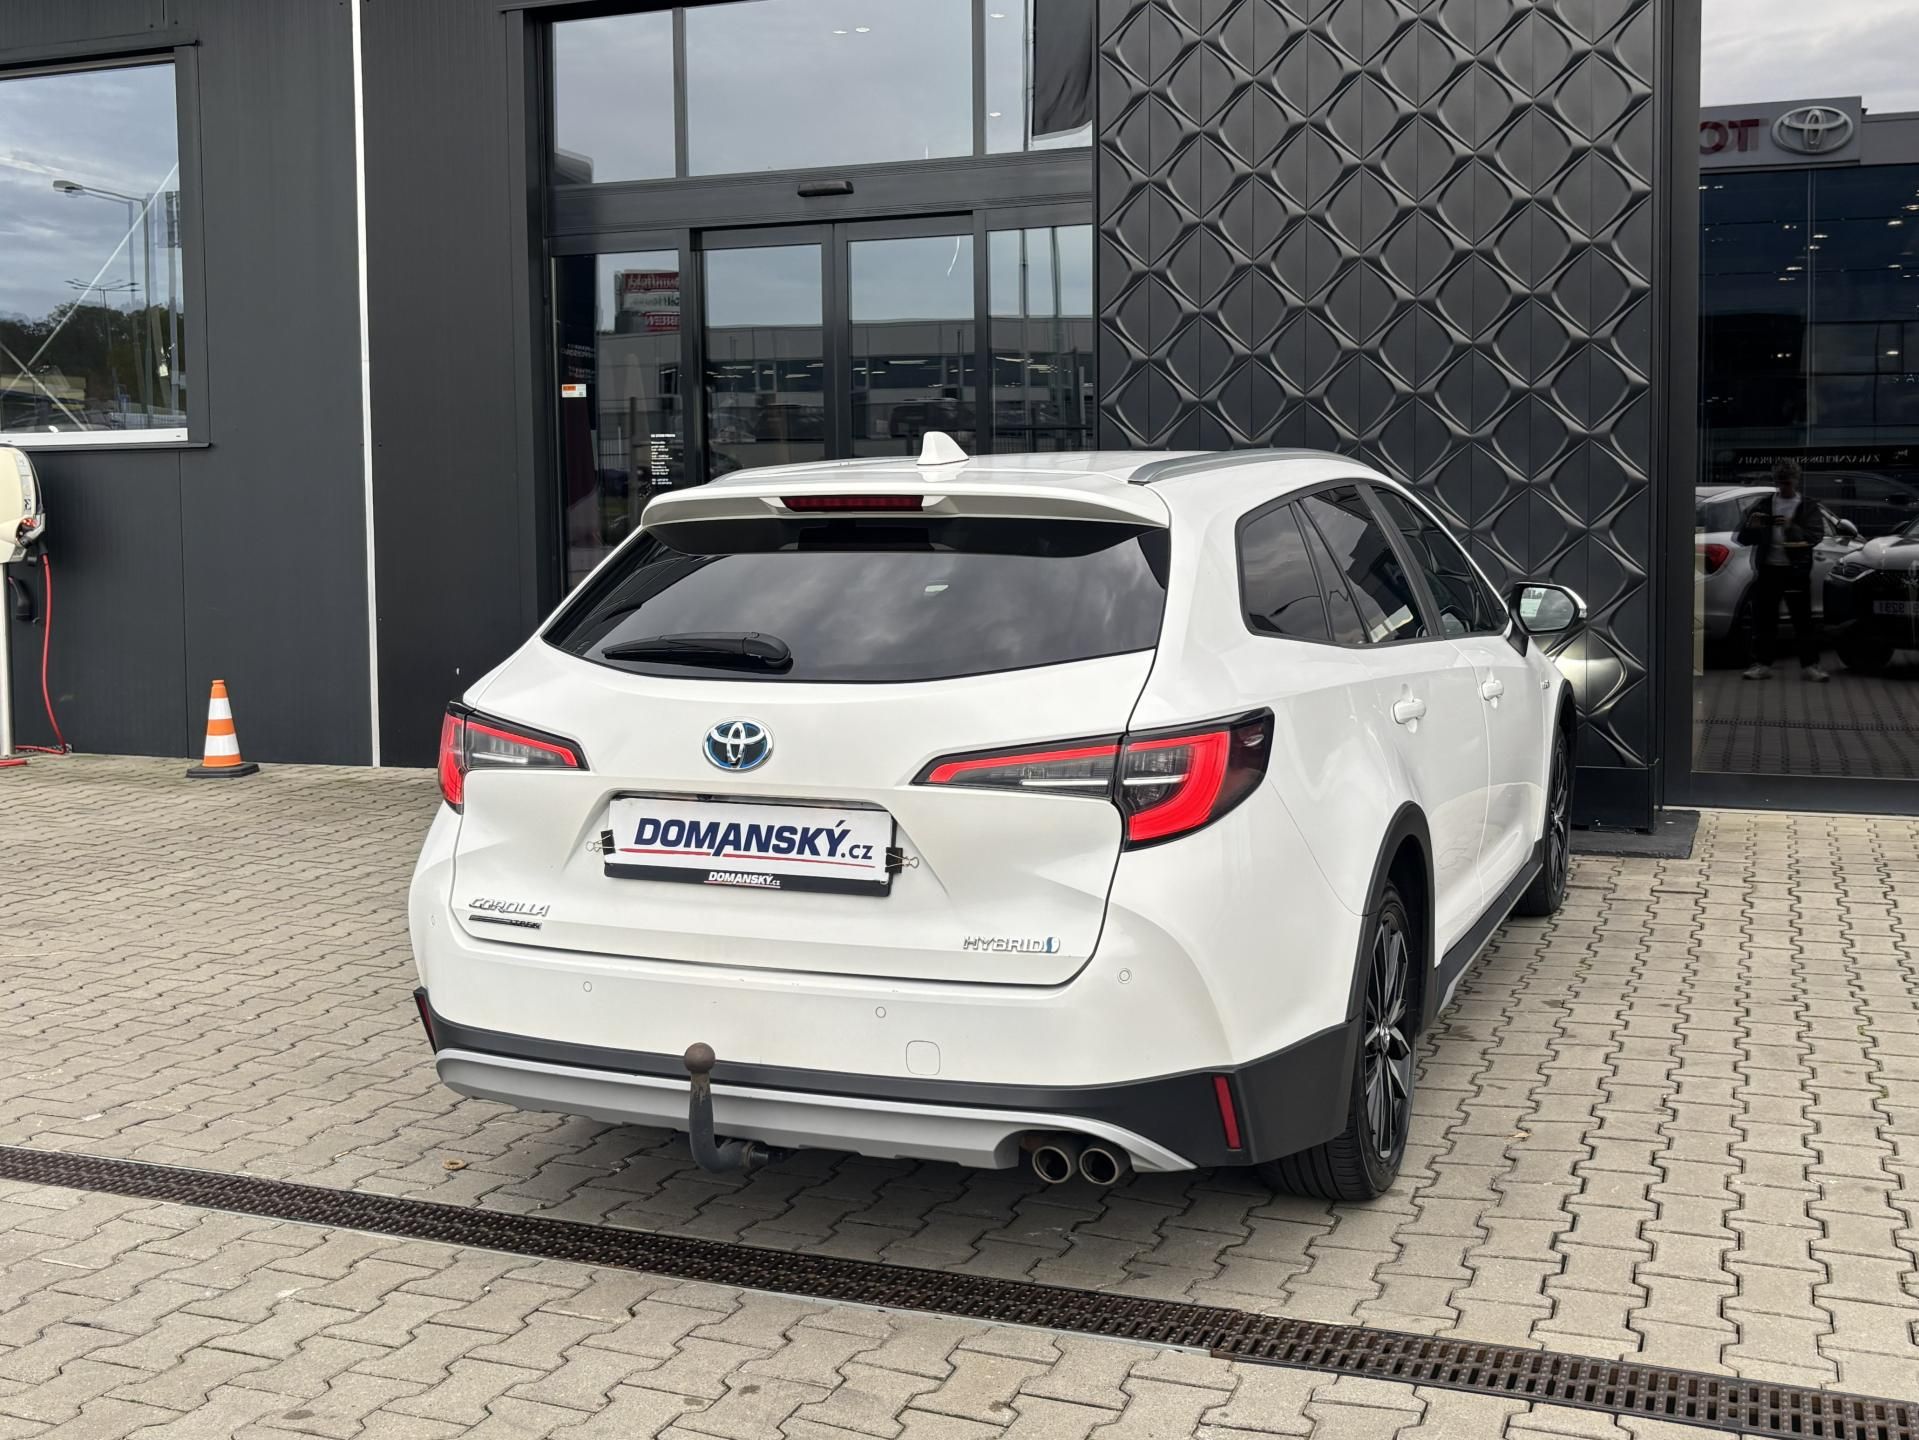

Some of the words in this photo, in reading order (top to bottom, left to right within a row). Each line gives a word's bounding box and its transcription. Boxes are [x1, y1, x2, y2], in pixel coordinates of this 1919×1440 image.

[634, 817, 873, 861] DOMANSKÝ.cz
[469, 897, 551, 917] COROLLA
[963, 935, 1044, 953] HYBRID
